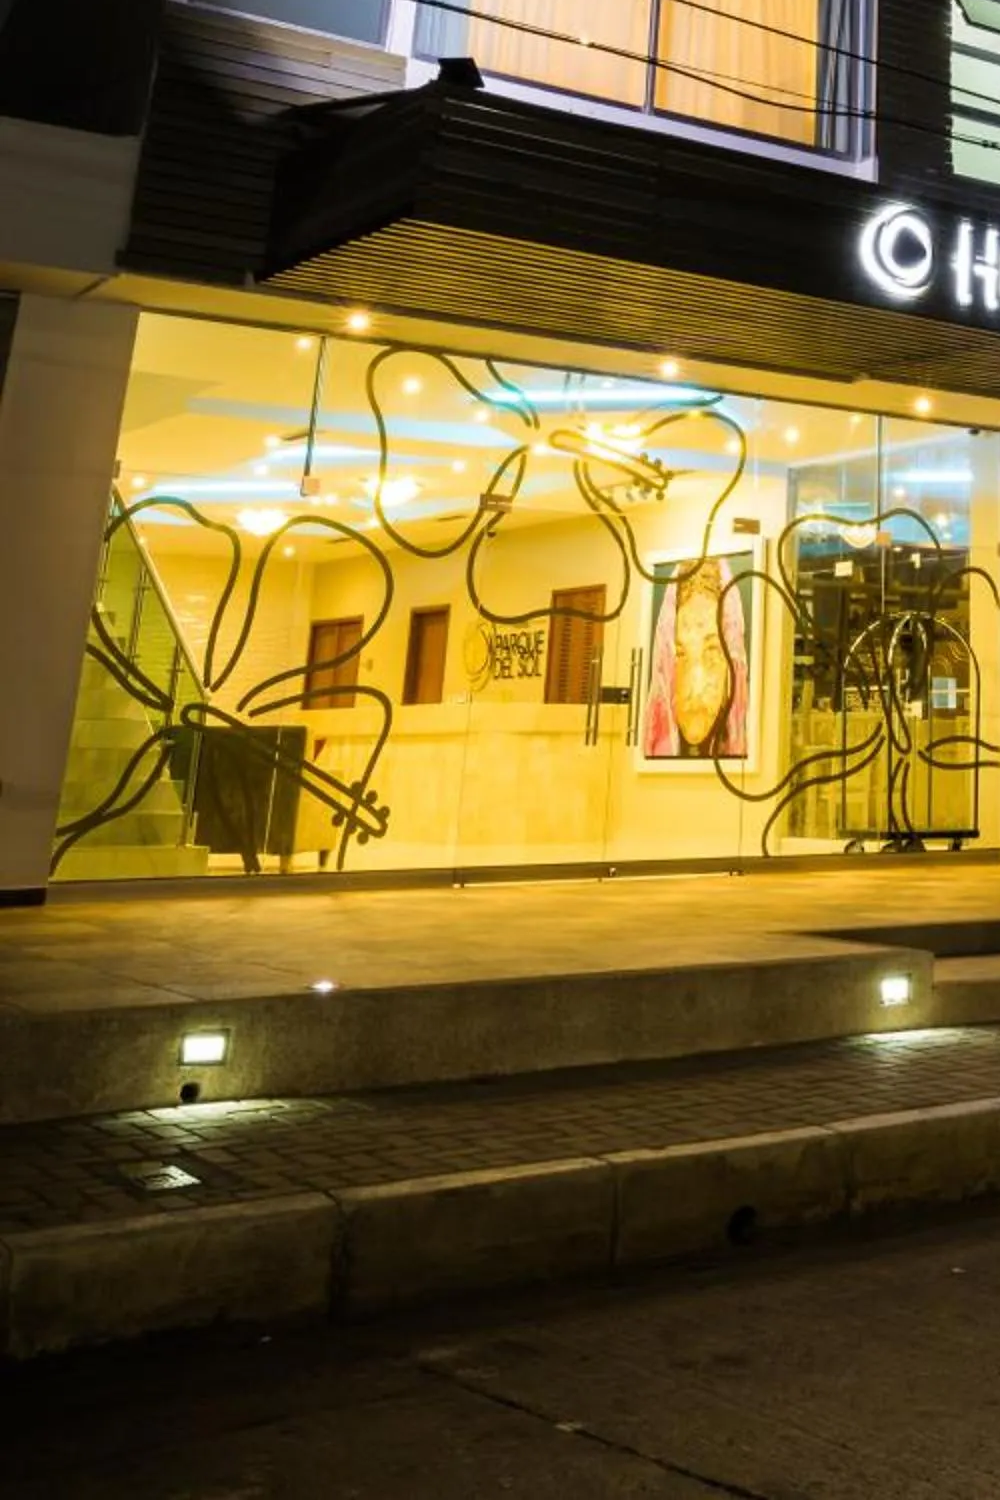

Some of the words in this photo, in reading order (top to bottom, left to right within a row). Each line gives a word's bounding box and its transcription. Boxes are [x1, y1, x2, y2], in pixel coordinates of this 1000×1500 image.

[495, 630, 545, 658] PARQUE
[494, 657, 513, 679] DEL
[517, 654, 542, 677] SOL
